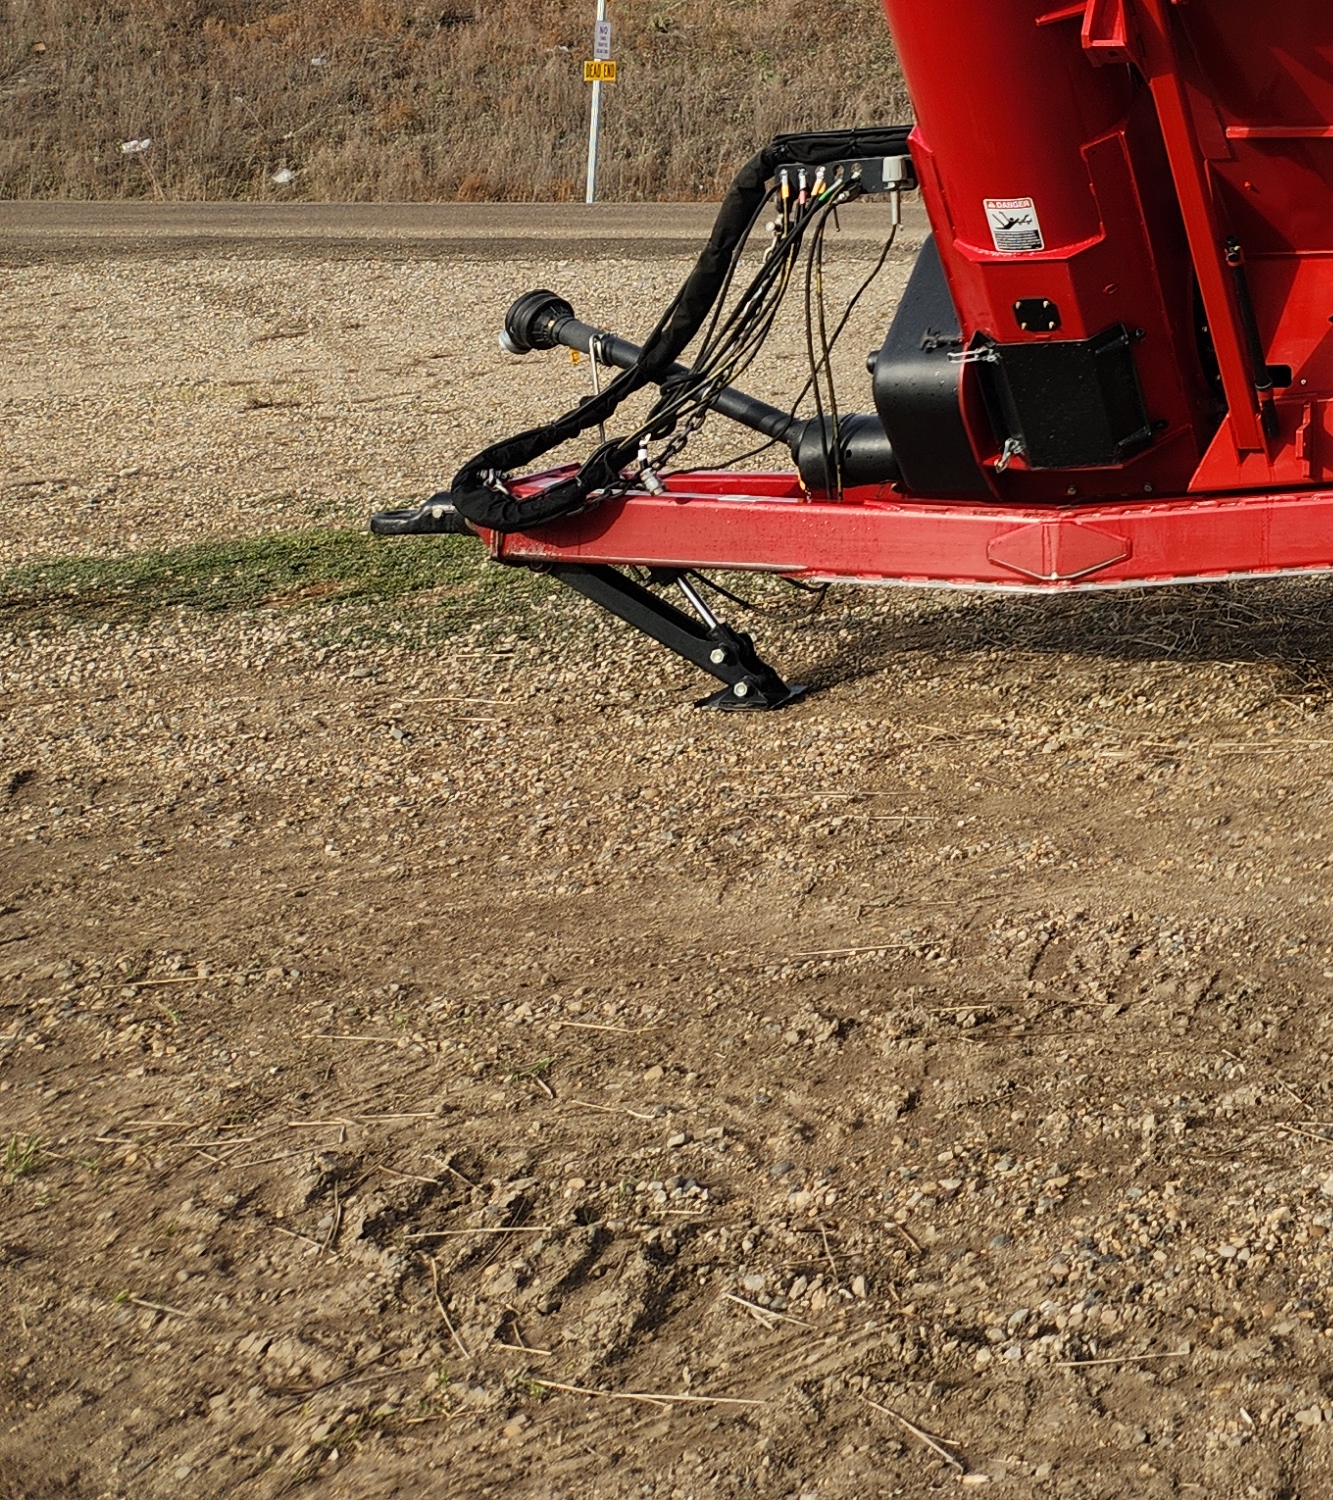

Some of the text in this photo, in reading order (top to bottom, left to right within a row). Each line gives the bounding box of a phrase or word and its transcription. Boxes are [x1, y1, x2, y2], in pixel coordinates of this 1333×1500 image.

[599, 26, 609, 35] NO
[586, 63, 614, 78] DEAD END
[996, 200, 1030, 209] DANGER
